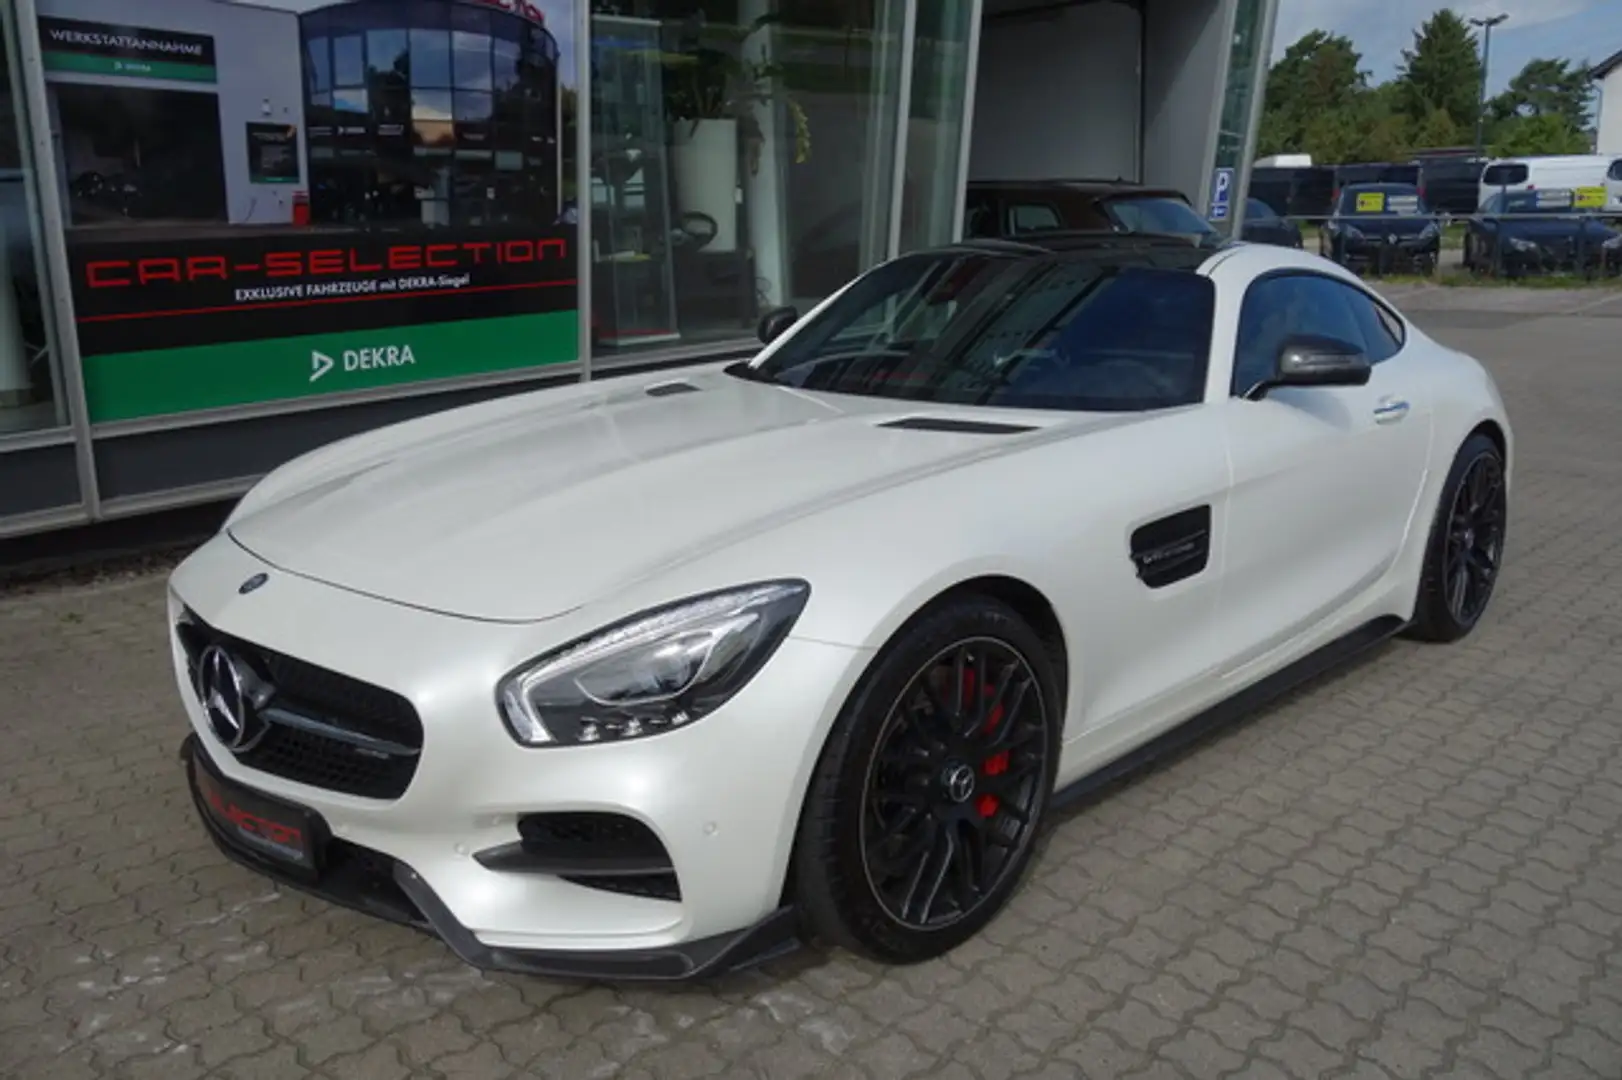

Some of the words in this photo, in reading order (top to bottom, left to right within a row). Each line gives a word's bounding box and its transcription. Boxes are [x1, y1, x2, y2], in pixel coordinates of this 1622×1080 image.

[50, 29, 203, 56] WERKSTATTANNAHME
[1214, 171, 1230, 202] P
[86, 239, 568, 288] CAR-SELECTION
[234, 283, 304, 302] EXKLUSIVE
[306, 279, 378, 297] FAHRZEUGE
[379, 278, 397, 291] mit
[399, 272, 470, 290] DEKRA-Siegel
[343, 345, 416, 371] DEKRA
